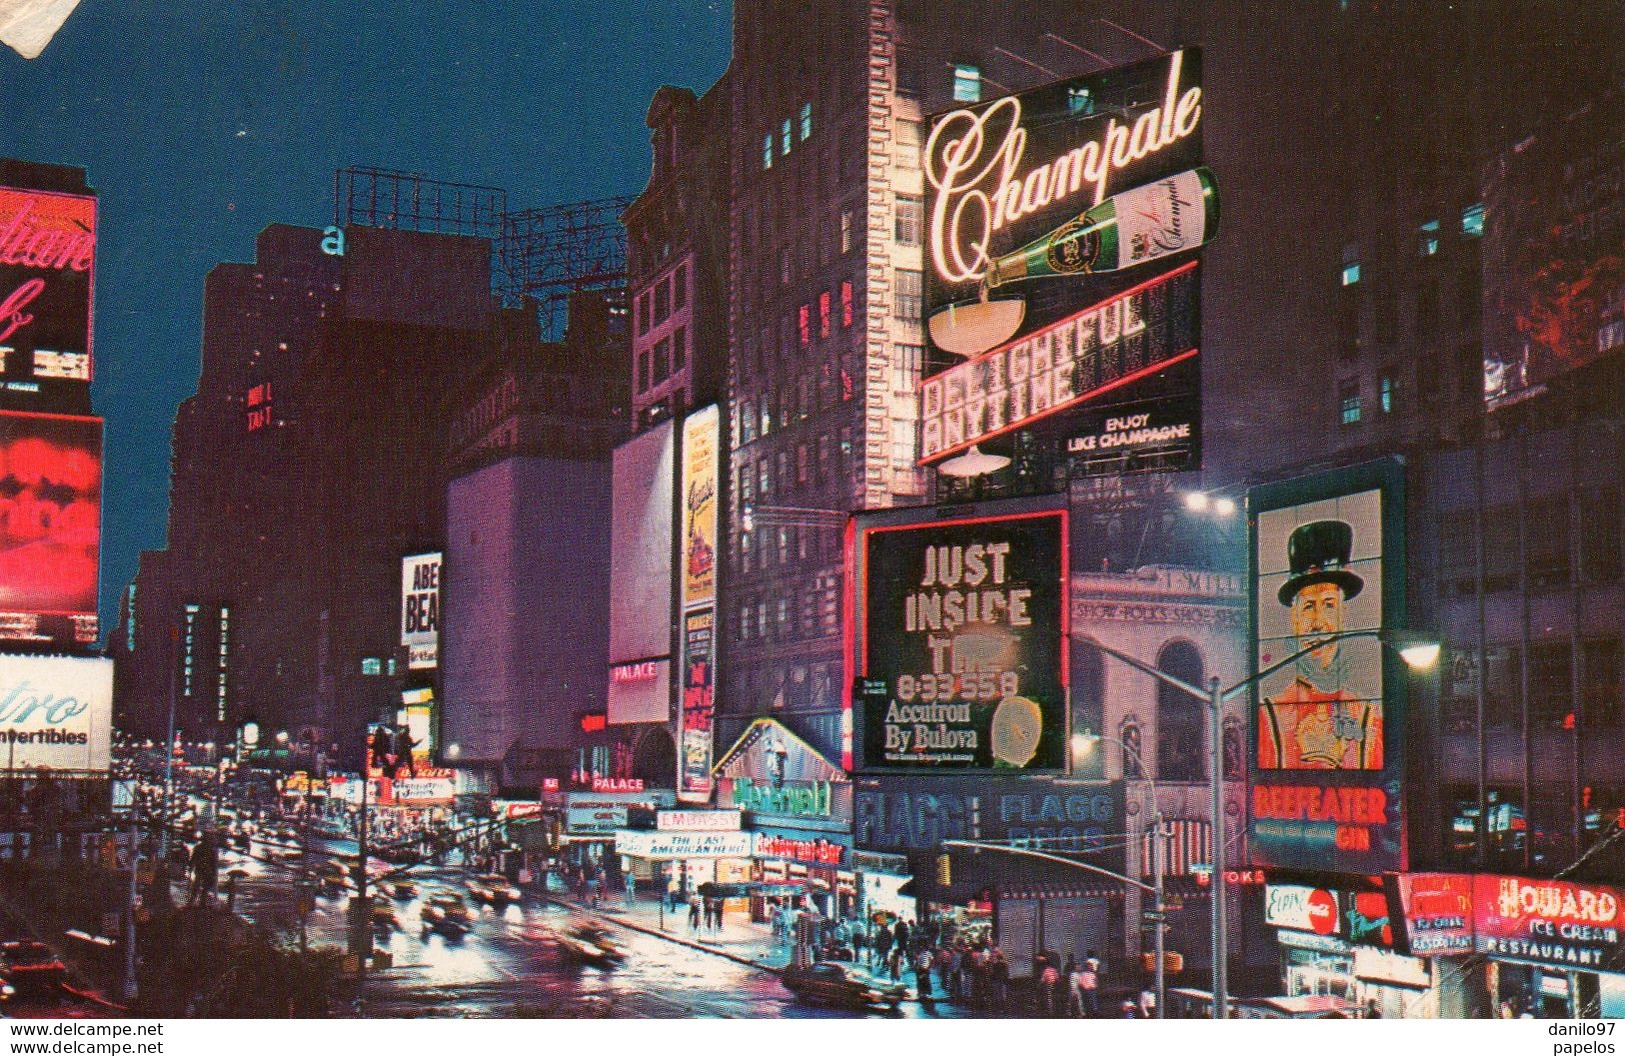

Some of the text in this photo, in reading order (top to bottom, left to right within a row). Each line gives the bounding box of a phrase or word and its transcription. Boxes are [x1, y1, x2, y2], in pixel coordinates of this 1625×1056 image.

[924, 50, 1202, 283] Champale
[321, 226, 344, 256] a
[922, 296, 1146, 421] DELIGHTFUL
[922, 361, 1076, 458] ANYTIME
[1106, 414, 1150, 430] ENJOY
[1068, 424, 1191, 452] LIKE CHAMPAGNE
[413, 561, 439, 591] ABE
[921, 543, 1010, 588] JUST
[405, 592, 439, 634] BEA
[184, 614, 194, 697] VICTORIA
[614, 663, 657, 683] PALACE
[885, 699, 970, 723] Accutron
[885, 723, 978, 752] By Bulova
[593, 778, 645, 791] PALACE
[1001, 795, 1114, 822] FLAGG
[1253, 785, 1388, 824] BEEFEATER
[661, 812, 739, 827] EMBASSY
[649, 845, 711, 855] AMERICAN
[1335, 826, 1370, 851] GIN
[1196, 869, 1266, 885] BOKS
[1497, 879, 1617, 922] HOWARD
[1530, 918, 1618, 943] ICE CREAM
[1487, 937, 1604, 965] RESTAURANT
